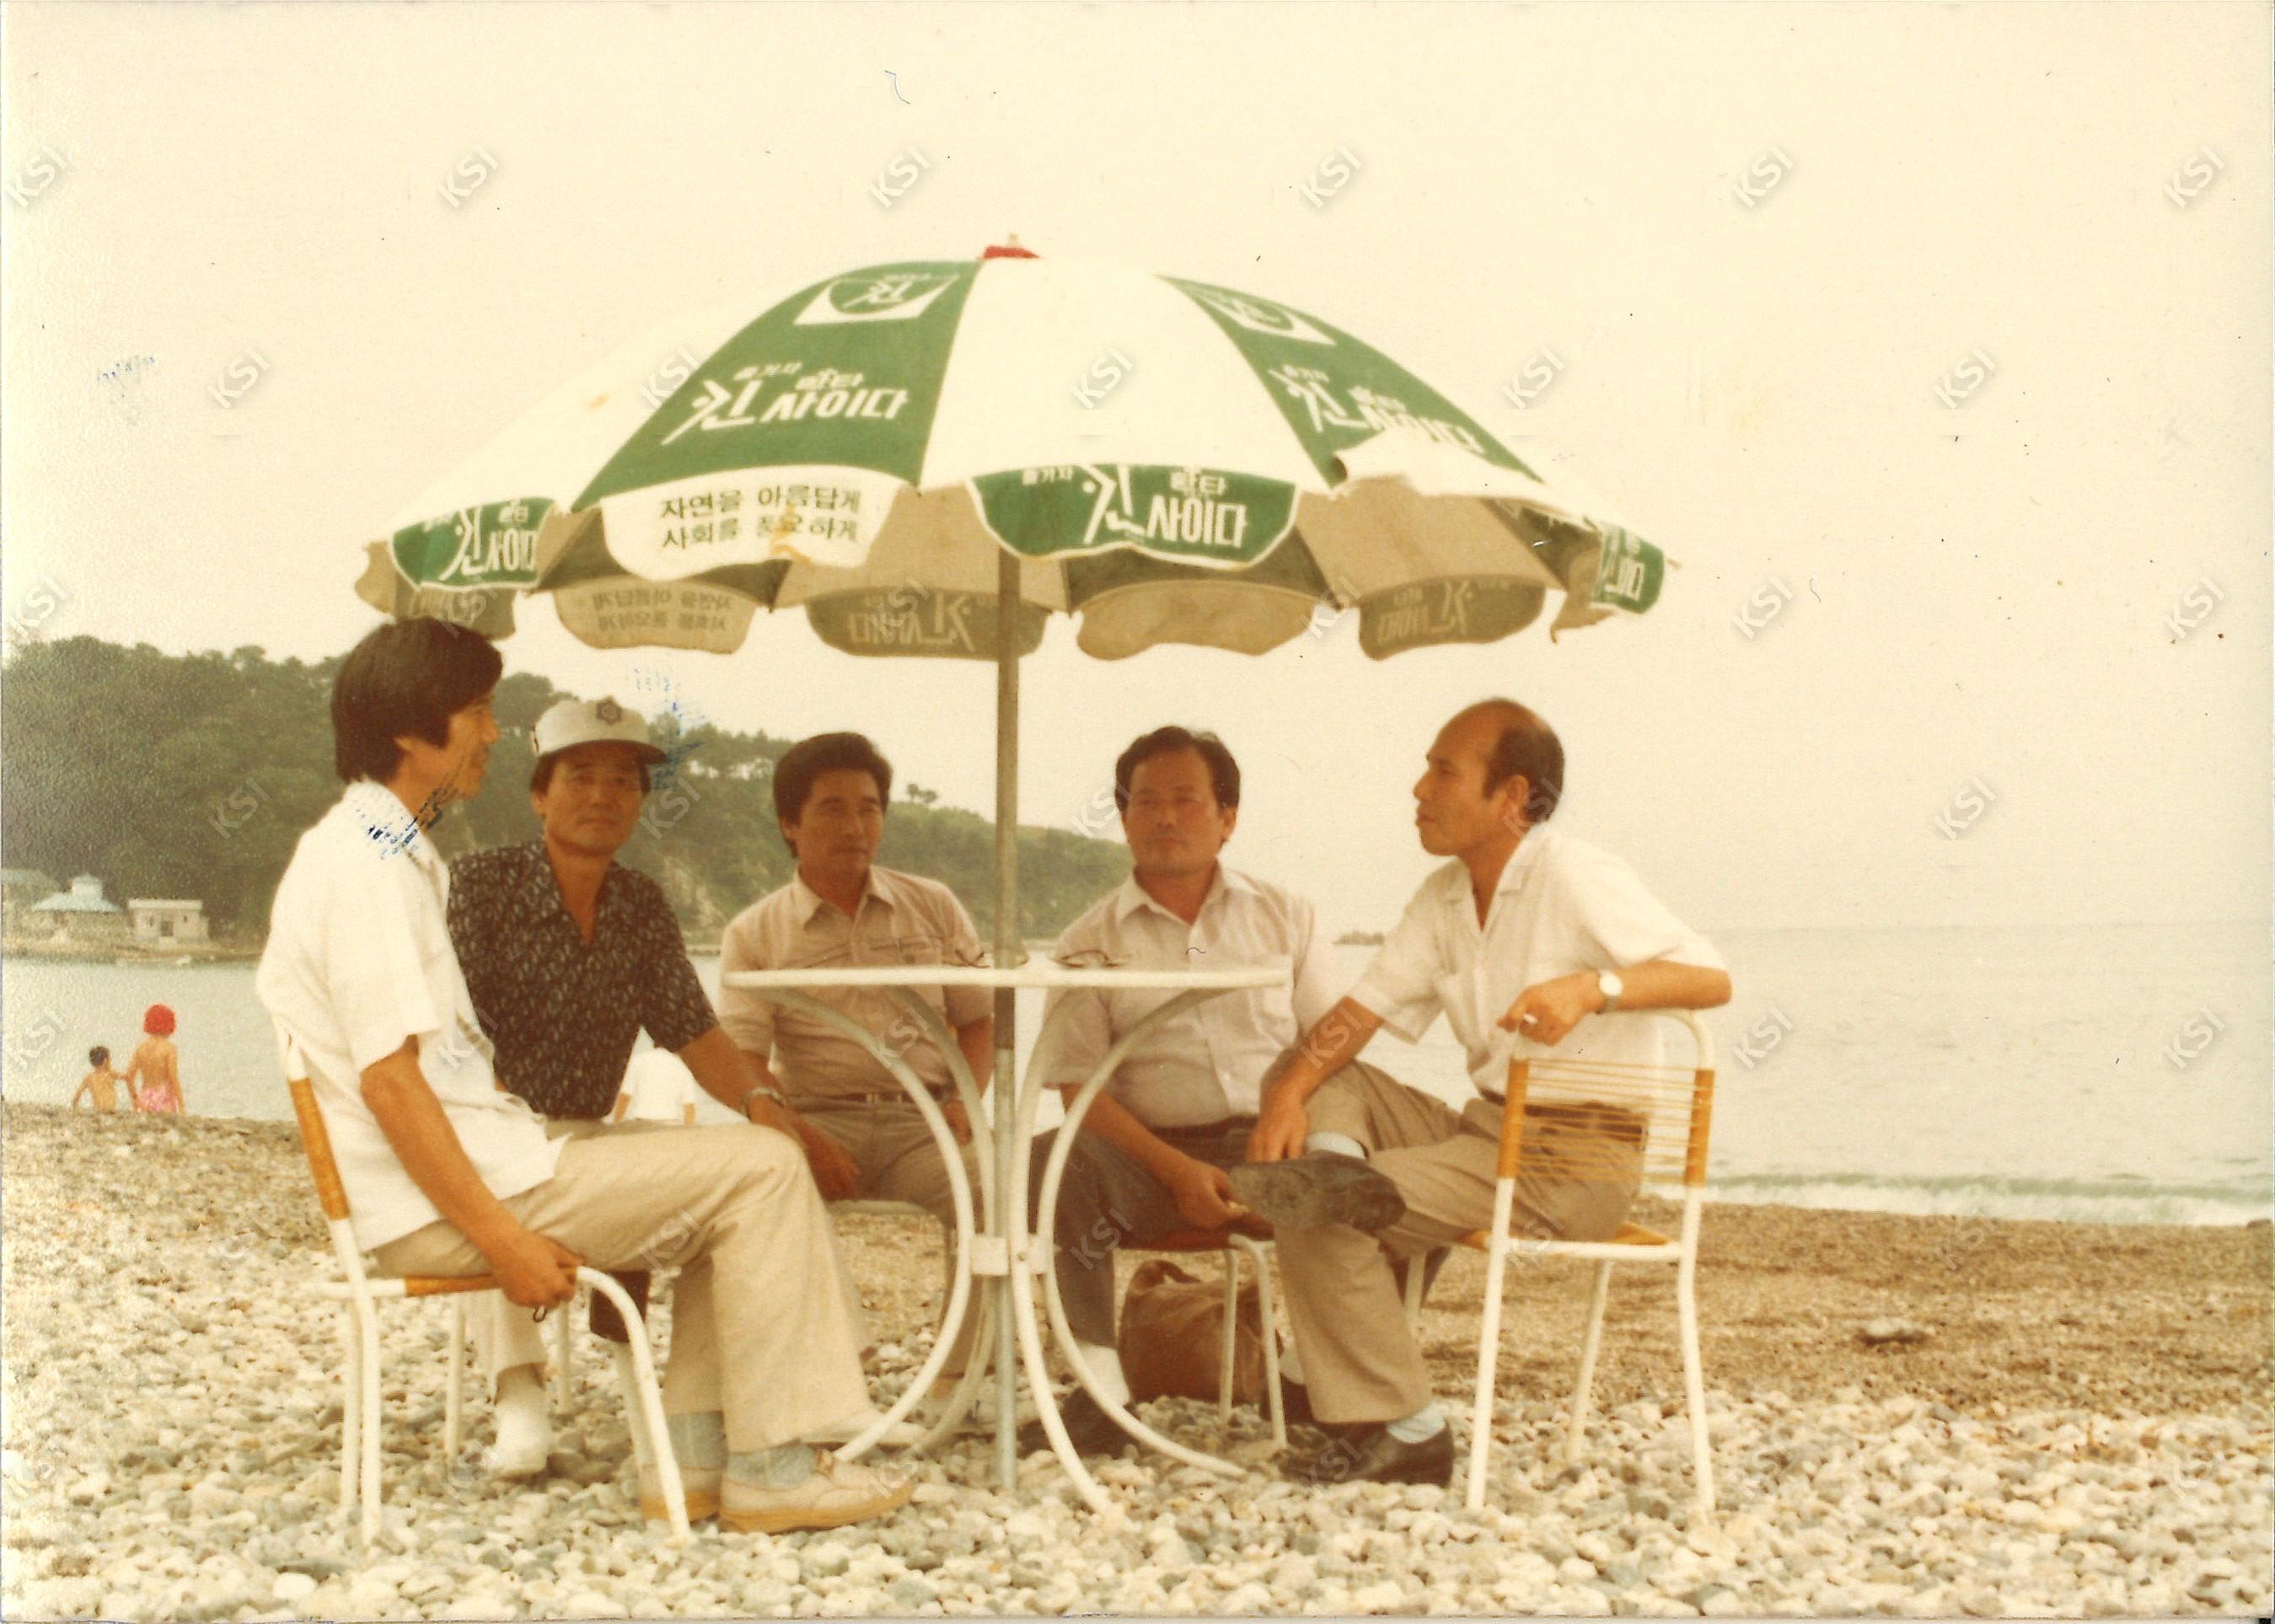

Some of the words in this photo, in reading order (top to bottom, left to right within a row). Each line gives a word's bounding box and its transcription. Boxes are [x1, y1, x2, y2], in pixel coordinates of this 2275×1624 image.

[760, 389, 909, 421] 사이다
[660, 489, 742, 520] 자연을
[758, 484, 861, 513] 아름답게
[661, 517, 738, 549] 사회를
[1146, 496, 1249, 548] 사이다
